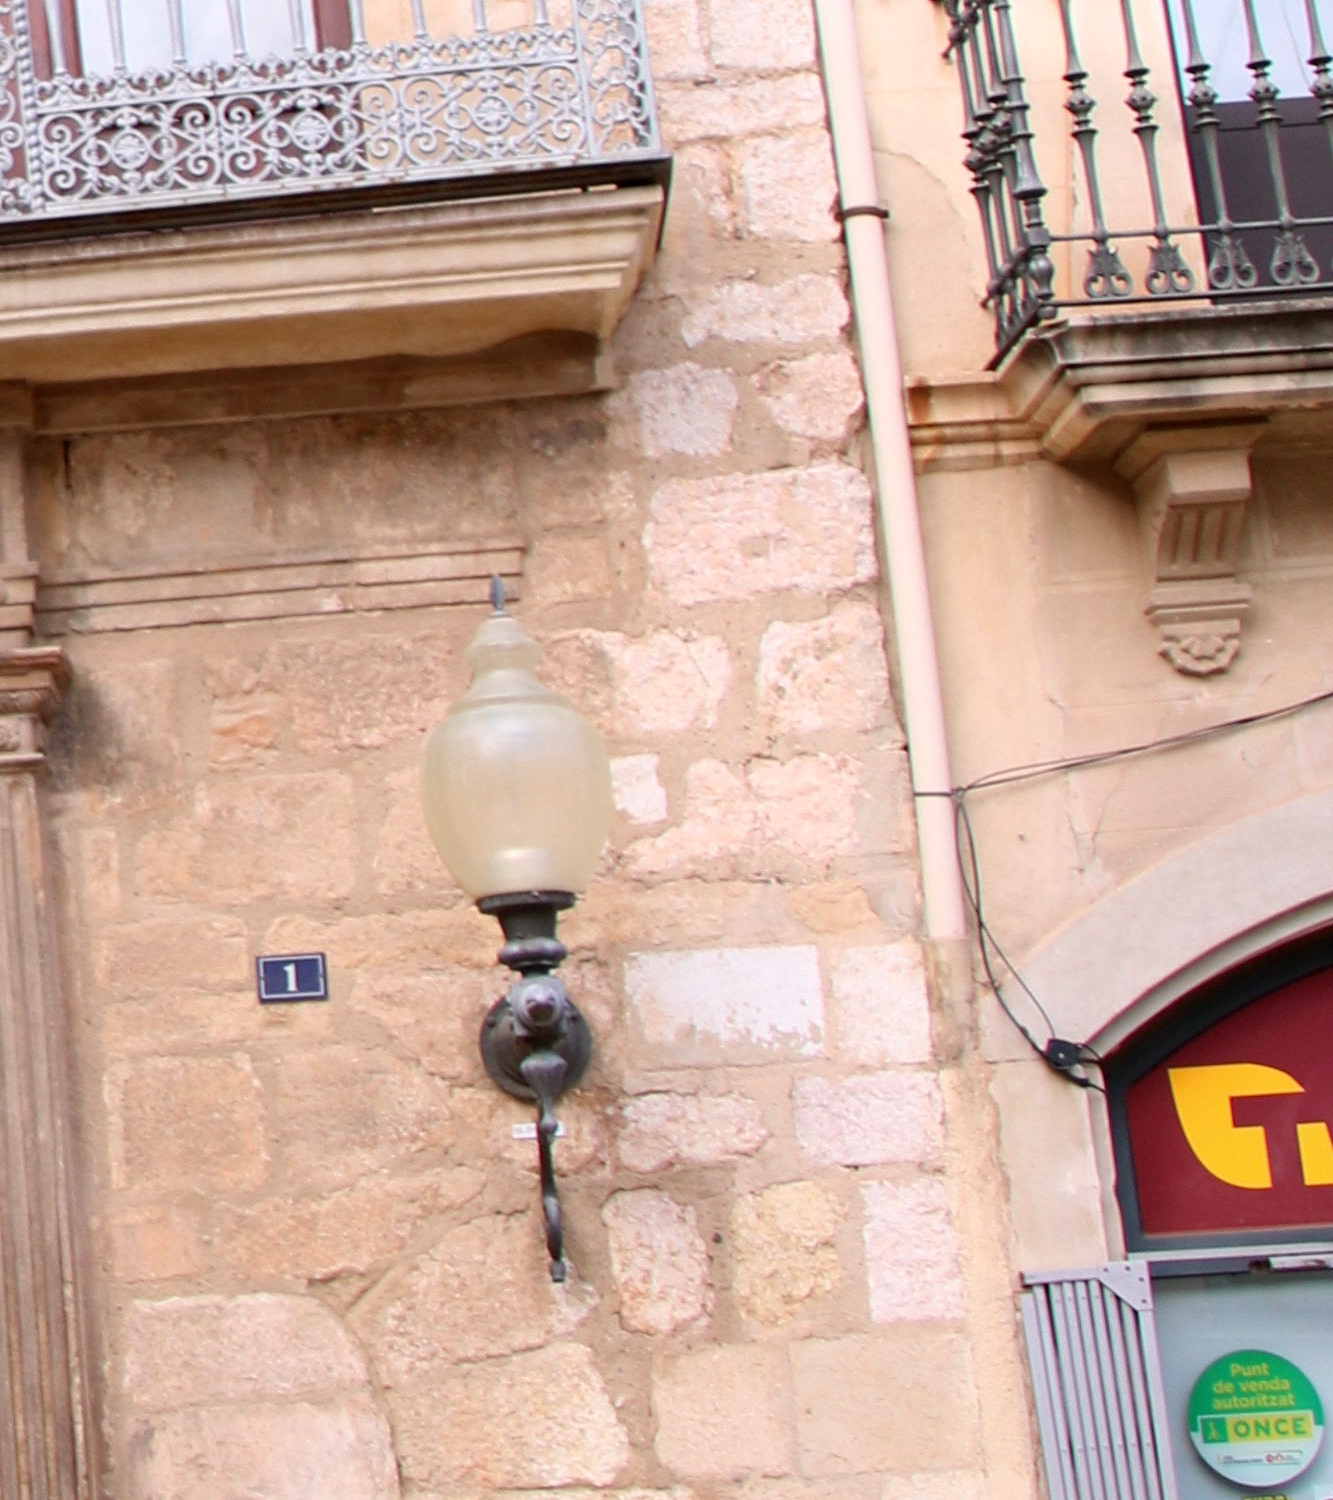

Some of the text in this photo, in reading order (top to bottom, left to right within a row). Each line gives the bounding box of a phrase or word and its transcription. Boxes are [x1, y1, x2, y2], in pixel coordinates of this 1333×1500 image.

[282, 962, 299, 992] 1
[1230, 1362, 1269, 1376] Punt
[1213, 1377, 1291, 1394] de venda
[1213, 1393, 1296, 1410] autoritzat
[1234, 1417, 1308, 1438] ONCE
